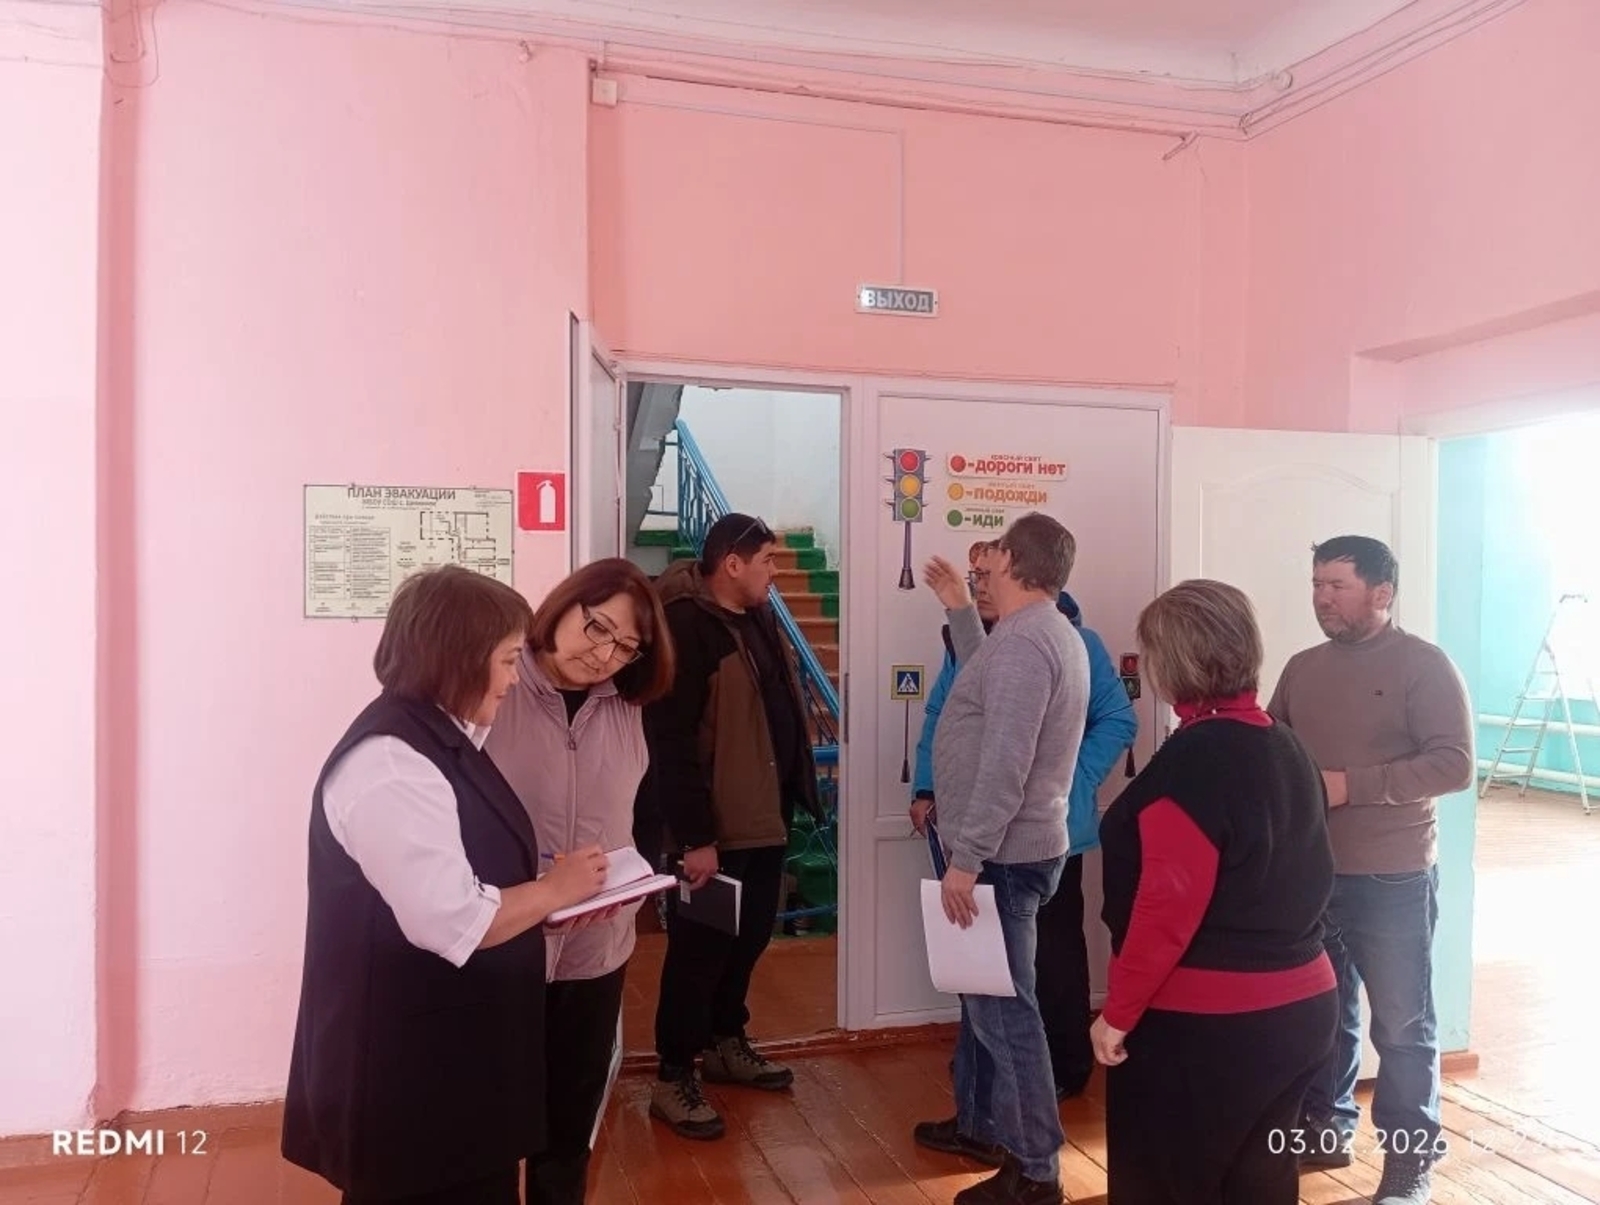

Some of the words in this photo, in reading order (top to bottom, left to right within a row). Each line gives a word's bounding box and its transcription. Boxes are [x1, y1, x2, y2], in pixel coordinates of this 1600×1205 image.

[863, 289, 930, 312] ВЫХОД
[1037, 463, 1066, 475] нет
[347, 487, 382, 499] ПЛАН
[384, 488, 456, 501] ЭВАКУАЦИИ
